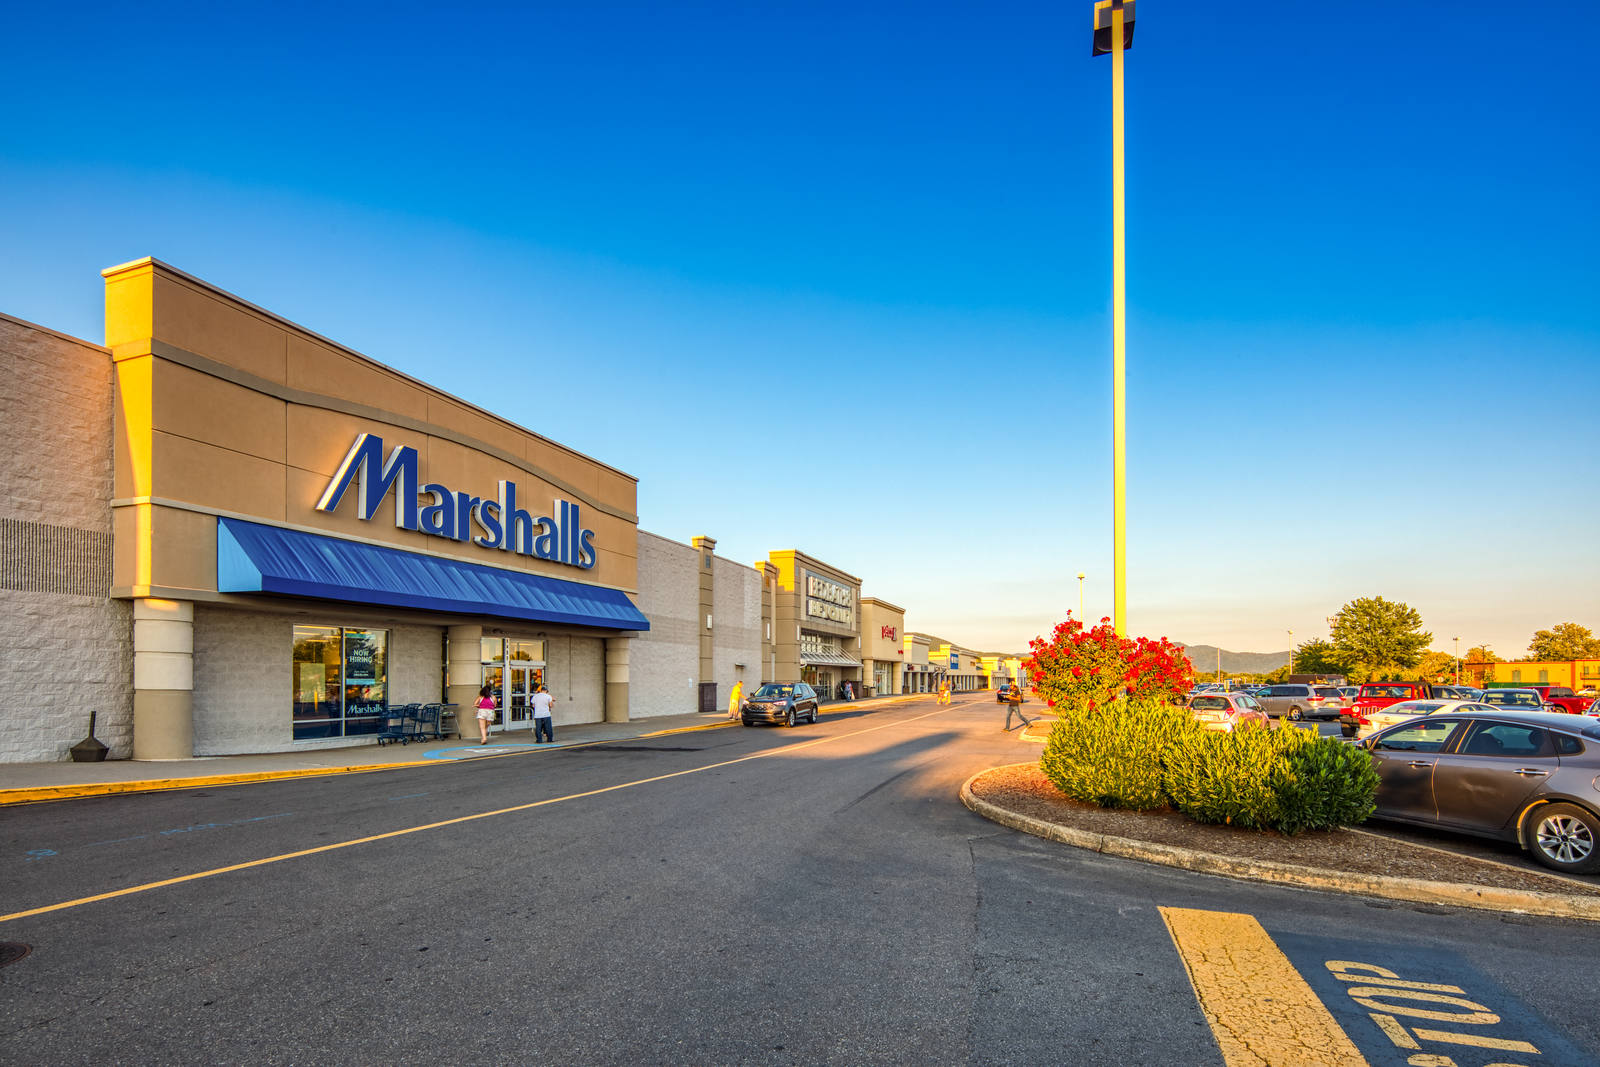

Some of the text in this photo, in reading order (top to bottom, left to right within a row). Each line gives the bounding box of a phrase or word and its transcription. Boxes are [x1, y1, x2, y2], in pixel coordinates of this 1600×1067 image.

[316, 433, 596, 569] Marshalls
[349, 656, 373, 664] HIRING
[347, 704, 382, 714] Marshalls
